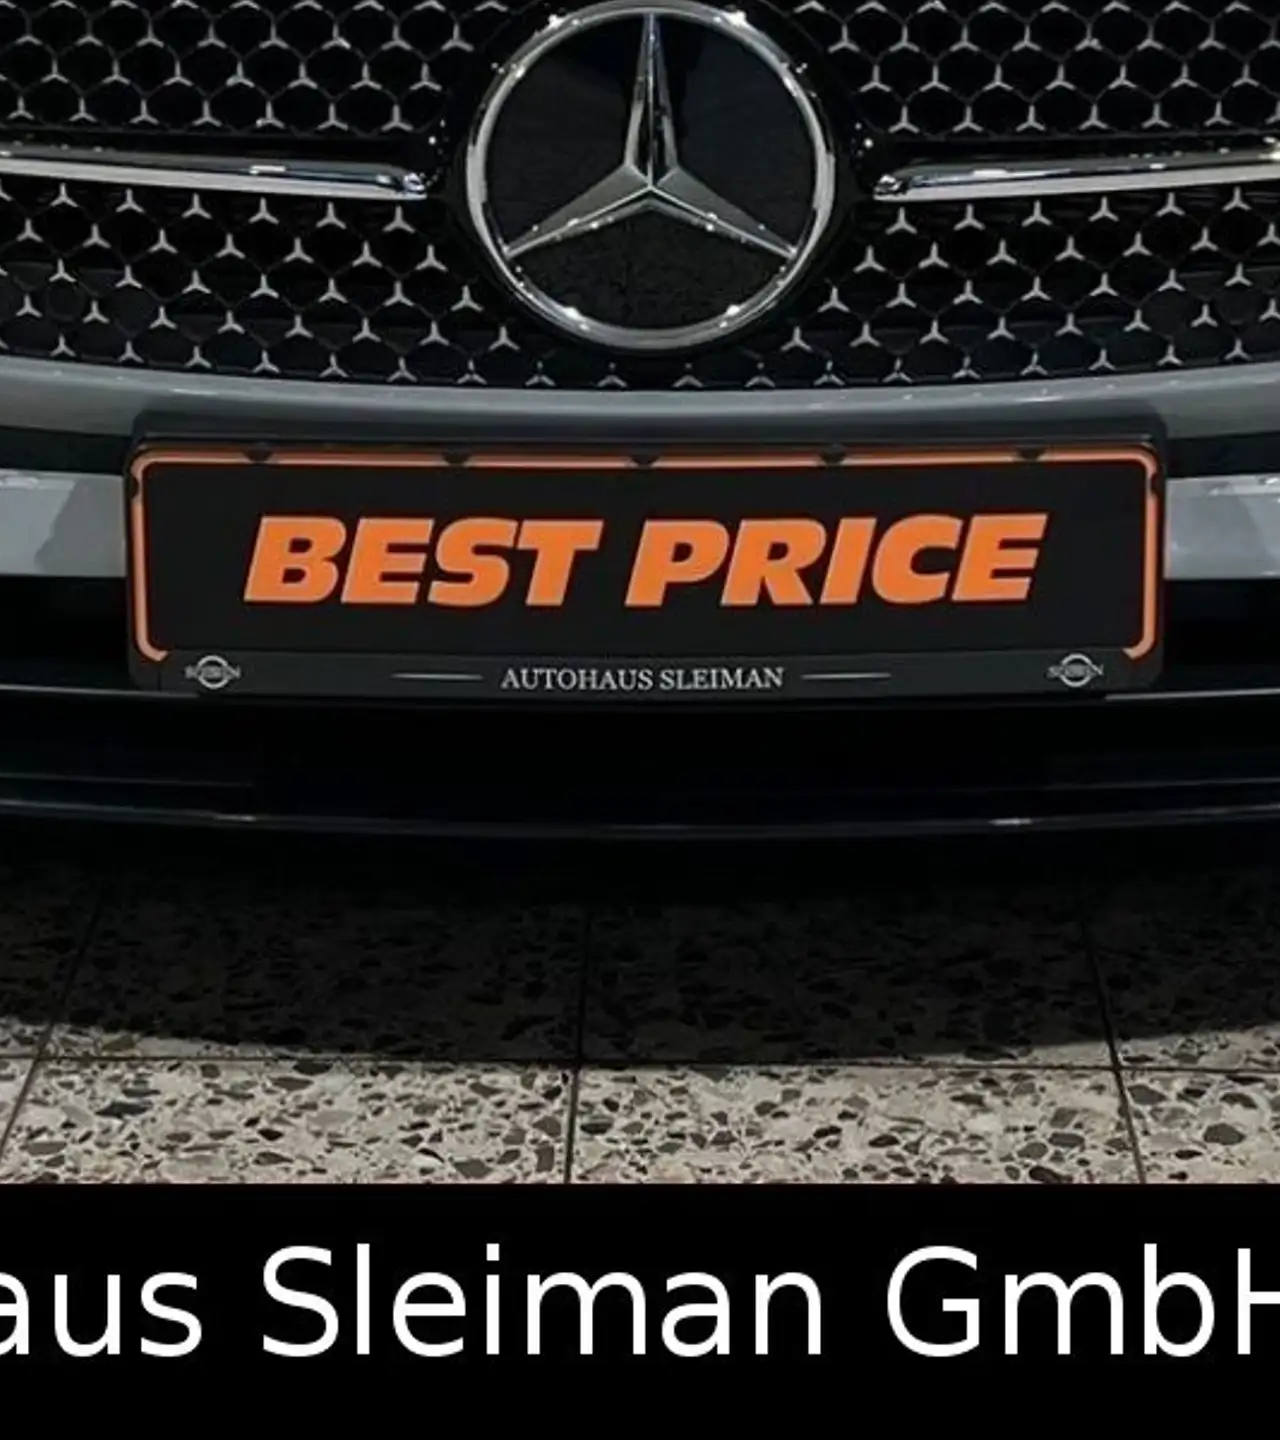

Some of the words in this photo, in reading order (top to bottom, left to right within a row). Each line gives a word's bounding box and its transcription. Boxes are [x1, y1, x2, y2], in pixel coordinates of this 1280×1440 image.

[243, 514, 604, 608] BEST
[624, 512, 1048, 608] PRICE
[500, 666, 654, 691] AUTOHAUS
[658, 665, 785, 691] SLEIMAN
